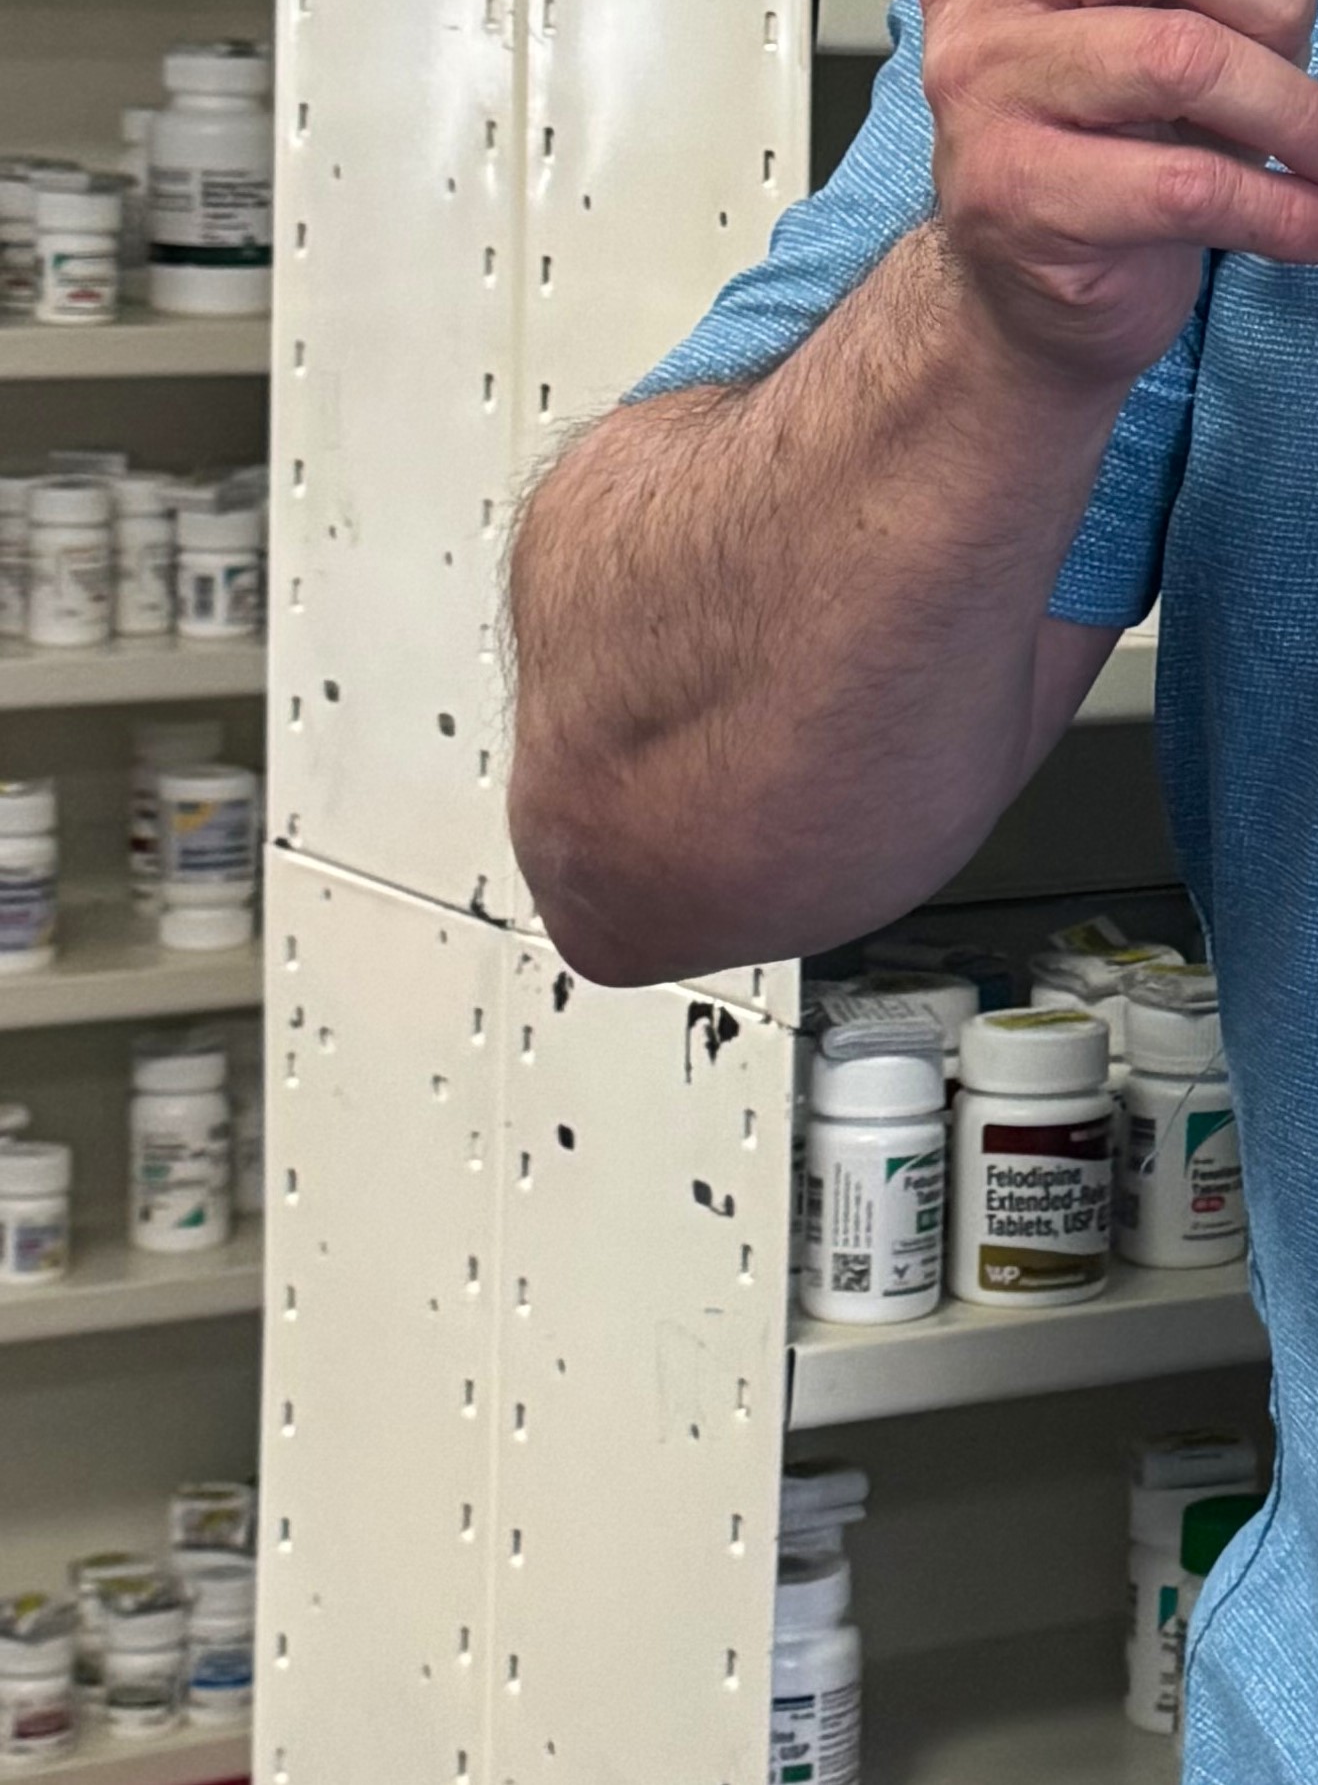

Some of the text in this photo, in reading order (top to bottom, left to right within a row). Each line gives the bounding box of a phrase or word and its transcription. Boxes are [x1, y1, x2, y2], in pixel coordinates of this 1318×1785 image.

[986, 1165, 1082, 1194] Felodipine
[985, 1208, 1095, 1239] Tablets, USP
